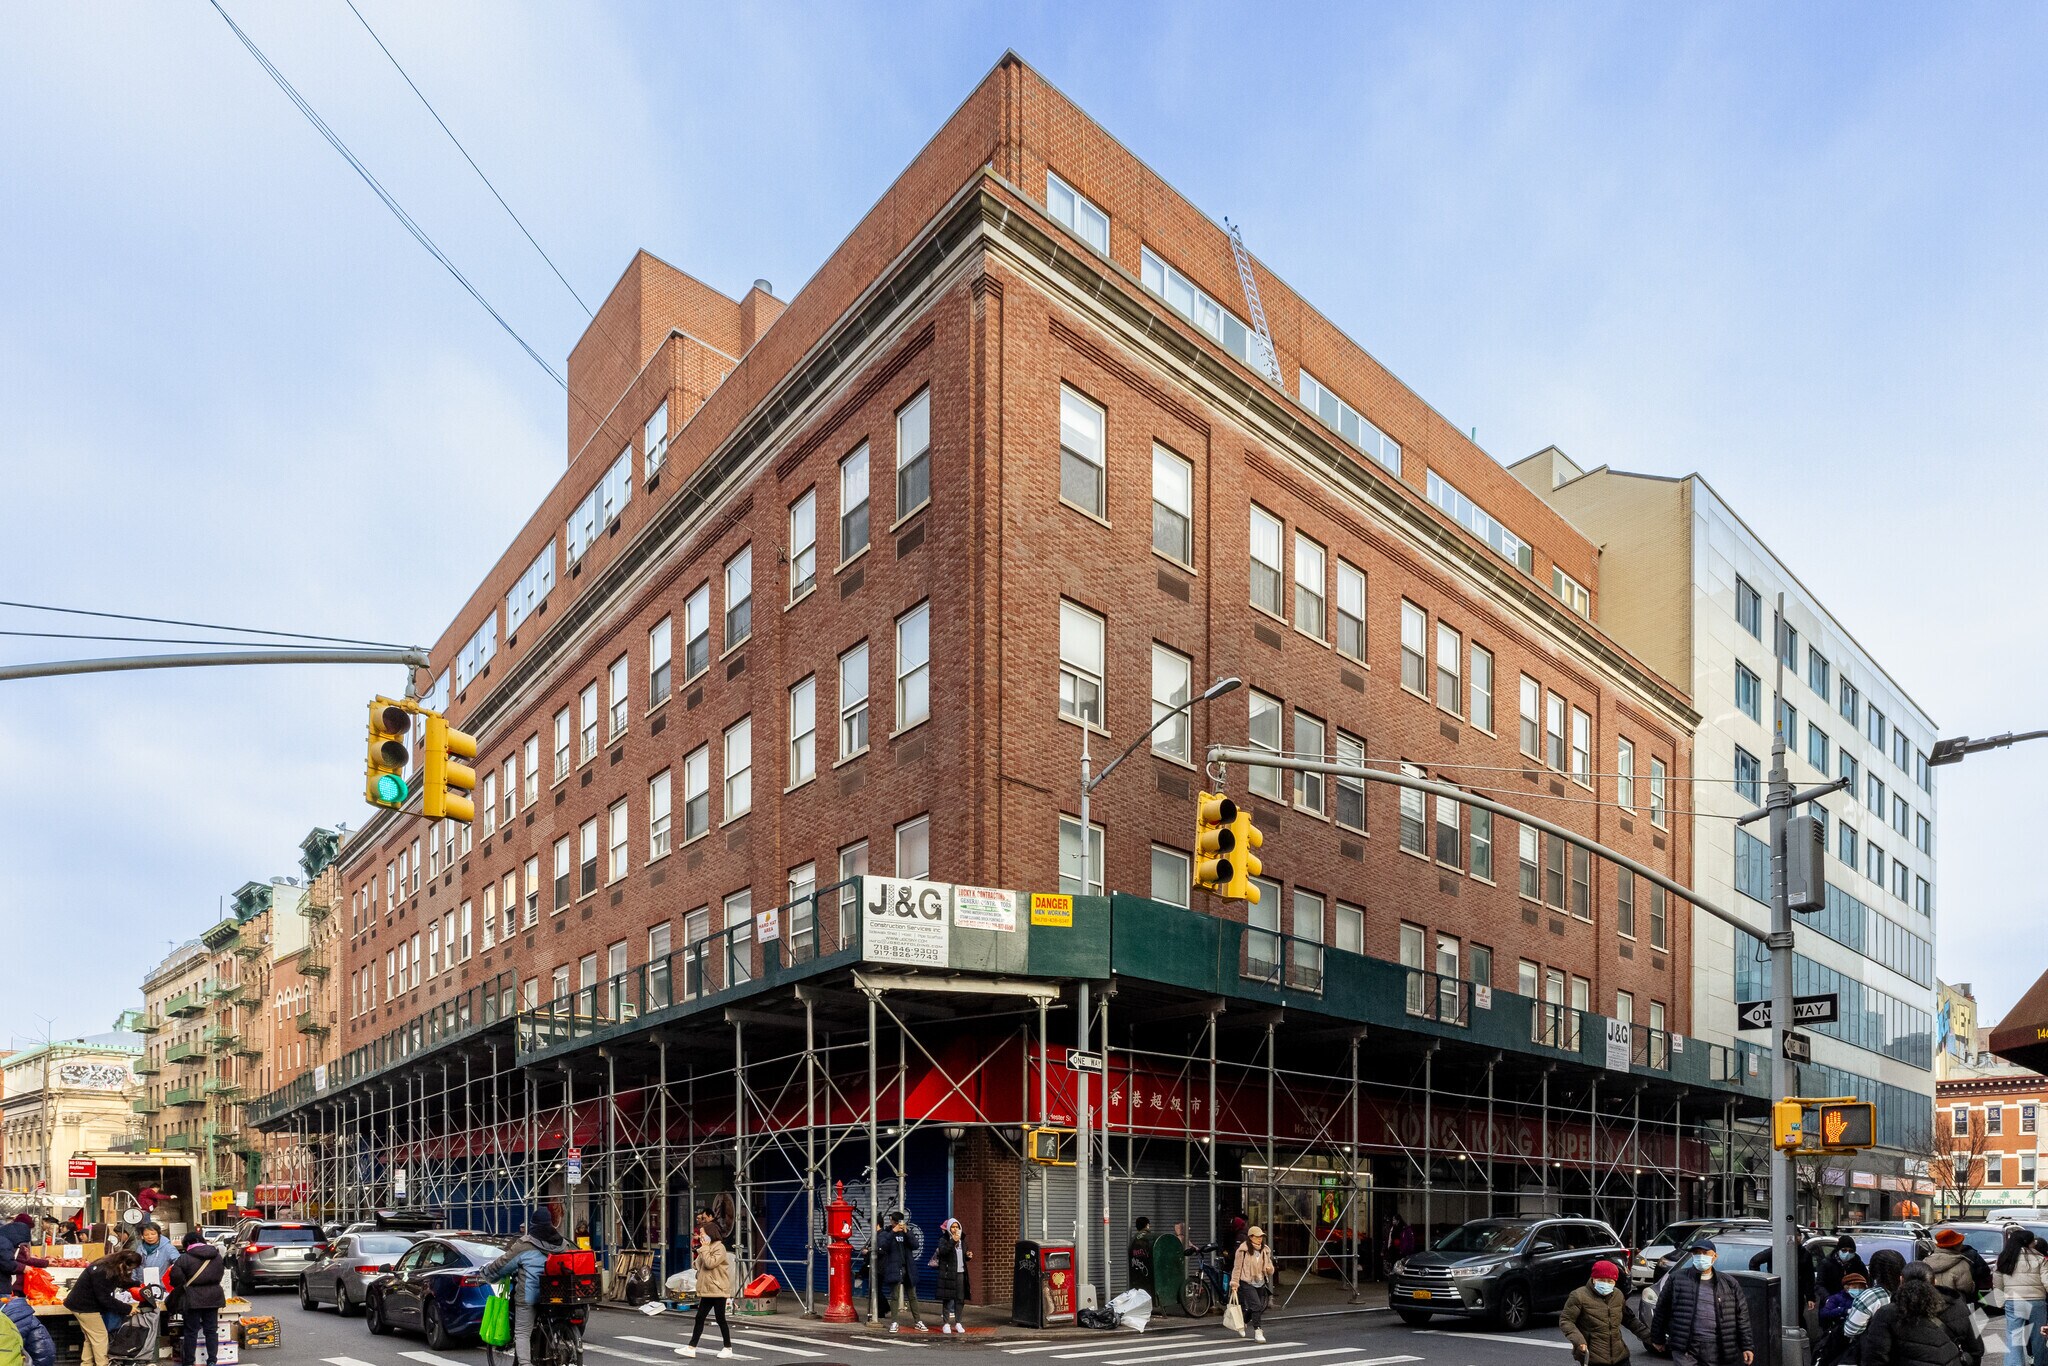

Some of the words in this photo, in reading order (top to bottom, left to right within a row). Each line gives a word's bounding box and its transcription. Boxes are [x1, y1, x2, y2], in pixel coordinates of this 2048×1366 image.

[868, 884, 942, 920] J&G
[1036, 897, 1068, 910] DANGER
[1753, 1008, 1770, 1020] ON
[1794, 1004, 1824, 1016] WAY
[1608, 1022, 1628, 1044] J&G
[1787, 1040, 1796, 1052] ONE
[1074, 1056, 1085, 1065] ONE
[1383, 1108, 1458, 1150] HONG
[1472, 1120, 1532, 1156] KONG
[1054, 1294, 1068, 1306] OVE
